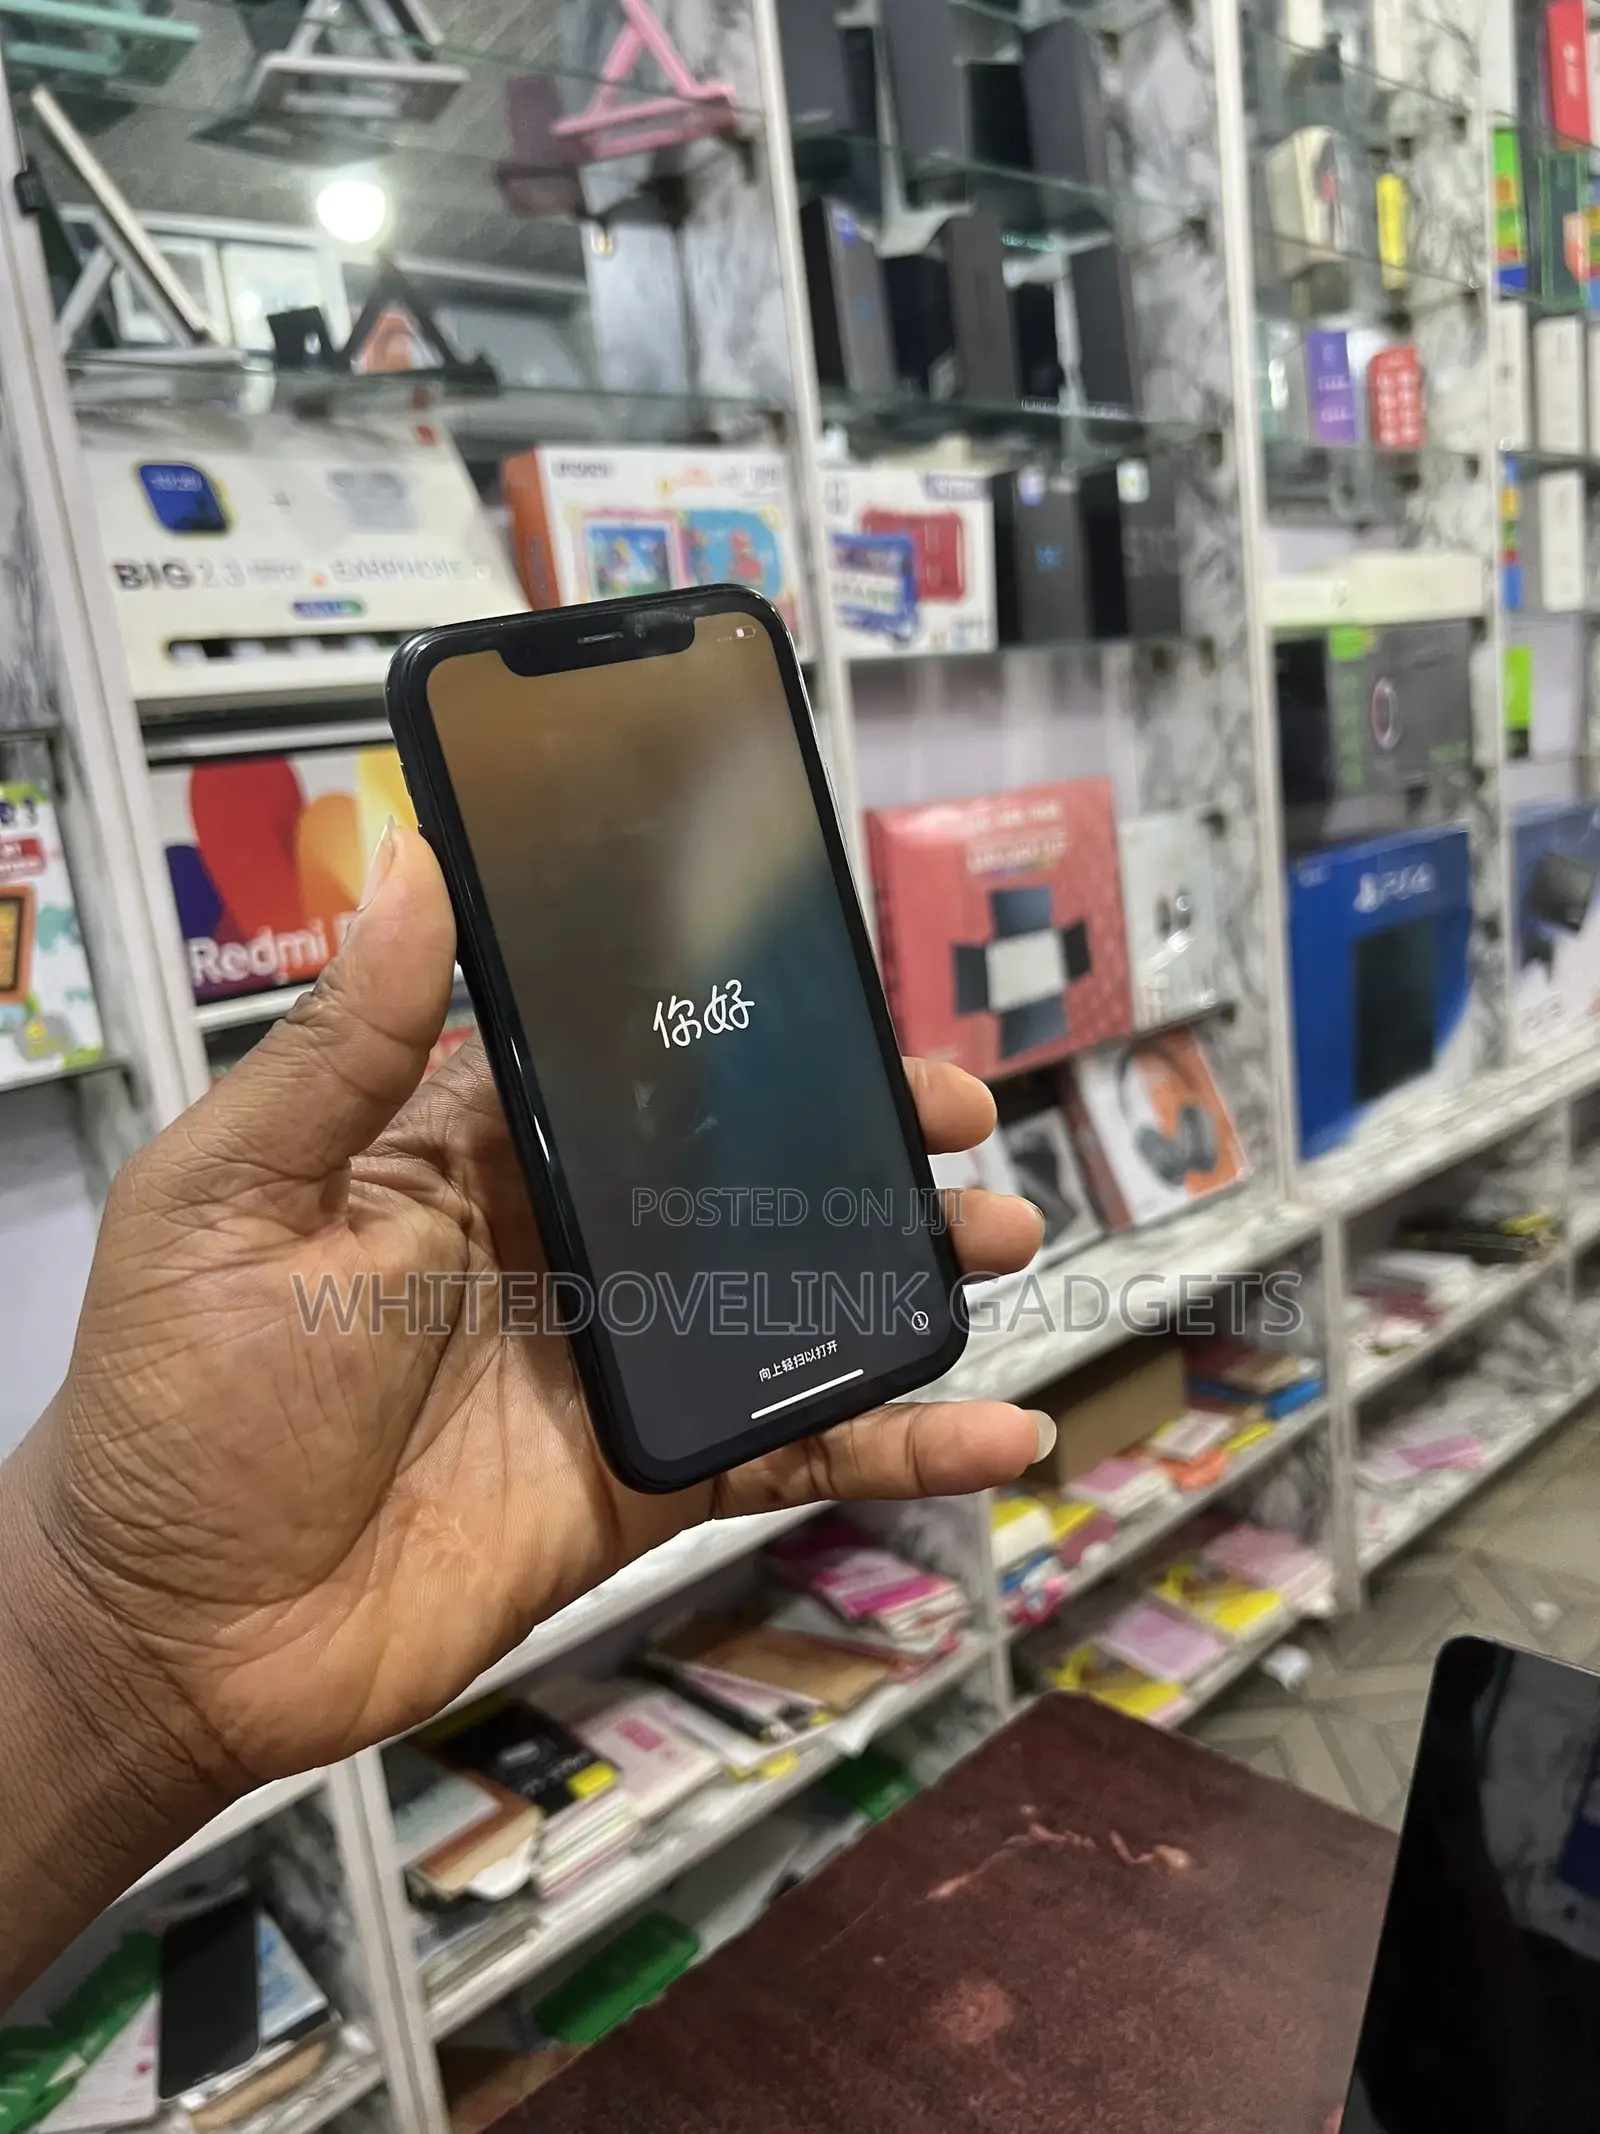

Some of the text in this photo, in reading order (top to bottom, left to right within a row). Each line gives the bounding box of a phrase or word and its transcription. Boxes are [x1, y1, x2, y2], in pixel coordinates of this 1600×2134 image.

[113, 561, 194, 591] BIG
[188, 917, 331, 986] Redmi
[653, 979, 755, 1048] 你好
[758, 1339, 839, 1383] 向上轻扫以打开
